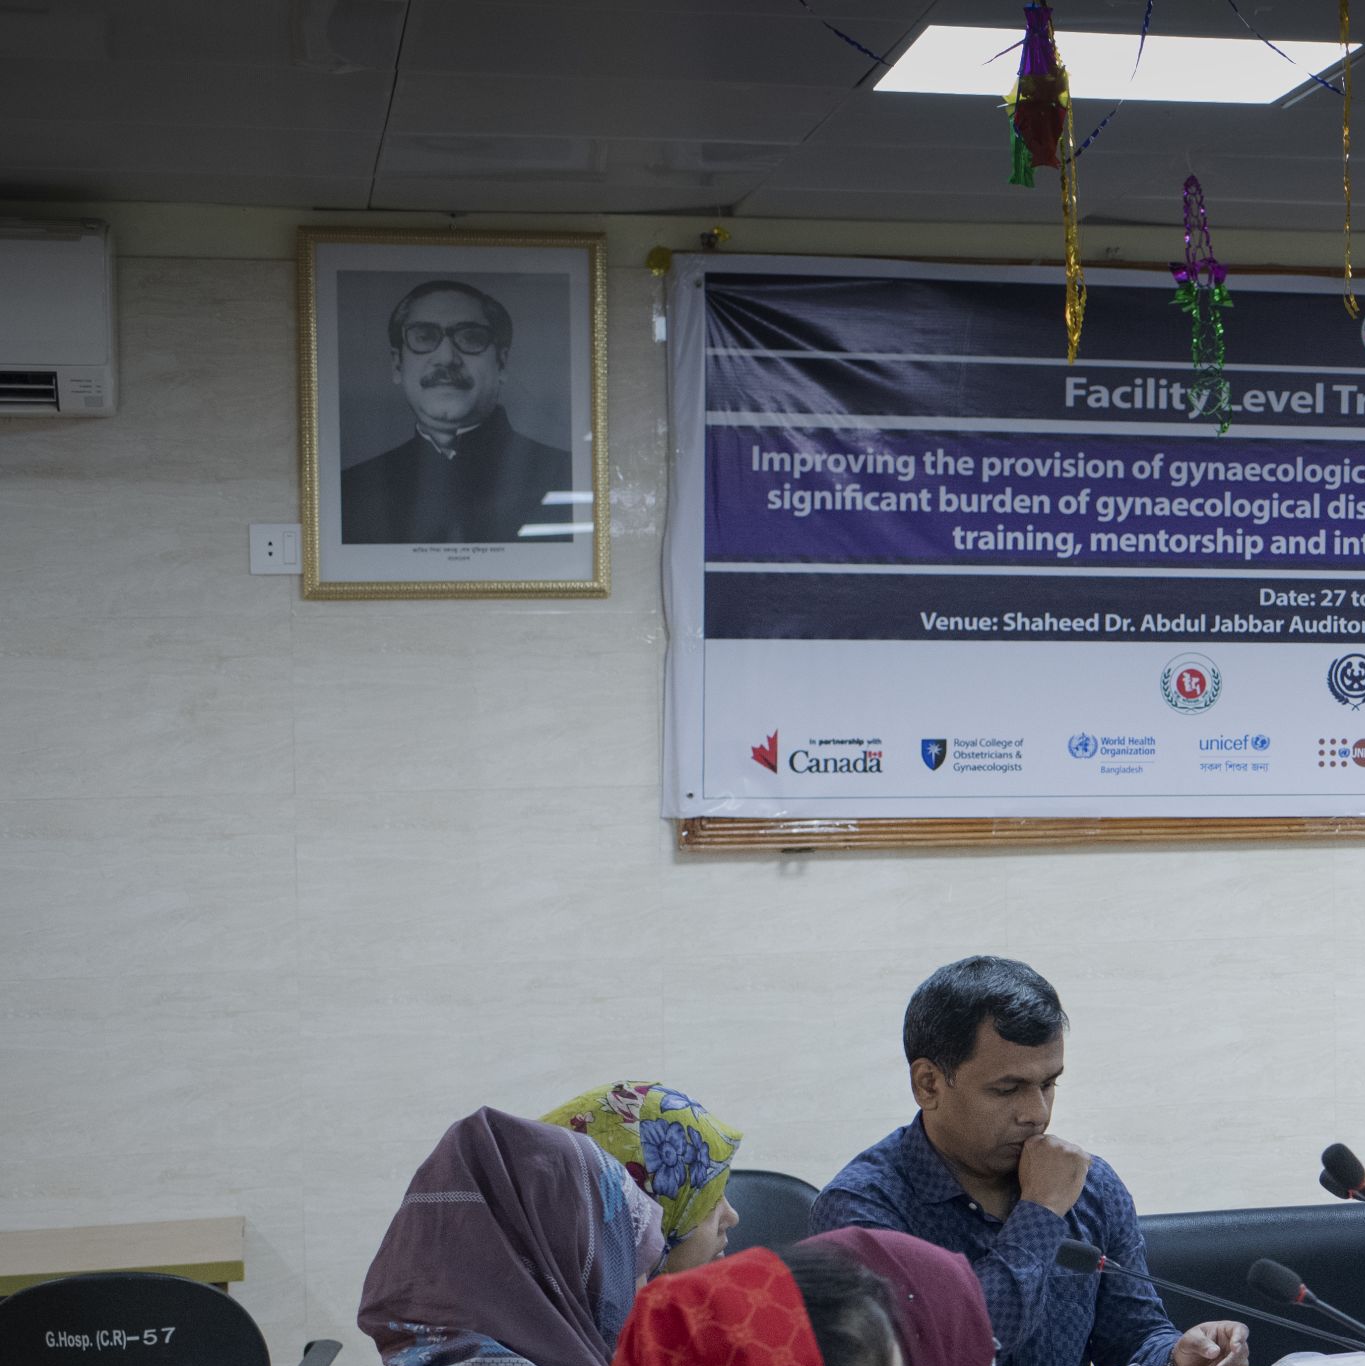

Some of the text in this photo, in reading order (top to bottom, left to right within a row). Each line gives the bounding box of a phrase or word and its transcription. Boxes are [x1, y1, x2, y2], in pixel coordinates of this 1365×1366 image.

[1065, 377, 1210, 420] Facility
[1223, 382, 1324, 415] Level
[753, 442, 915, 481] Improving
[923, 449, 974, 475] the
[983, 452, 1124, 482] provision
[1132, 454, 1164, 479] of
[768, 483, 931, 516] significant
[940, 486, 1050, 513] burden
[1059, 489, 1090, 514] of
[1096, 492, 1319, 524] gynaecological
[953, 525, 1082, 558] training,
[1091, 528, 1263, 560] mentorship
[1271, 530, 1325, 554] and
[1260, 589, 1315, 606] Date:
[1321, 590, 1346, 606] 27
[921, 612, 997, 630] Venue:
[1004, 612, 1099, 631] Shaheed
[1105, 614, 1135, 631] Dr.
[1141, 614, 1205, 632] Abdul
[1211, 615, 1284, 632] Jabbar
[818, 738, 864, 746] partnership
[954, 738, 1023, 748] Royal College of
[1101, 736, 1155, 745] World Health
[1200, 734, 1249, 750] unicef
[953, 750, 1022, 759] Obstetricians &
[1100, 747, 1155, 758] Organization
[789, 749, 883, 773] Canada
[953, 762, 1022, 772] Gynaecologists
[1100, 766, 1143, 776] Bangladesh
[45, 1330, 93, 1351] G.Hosp.
